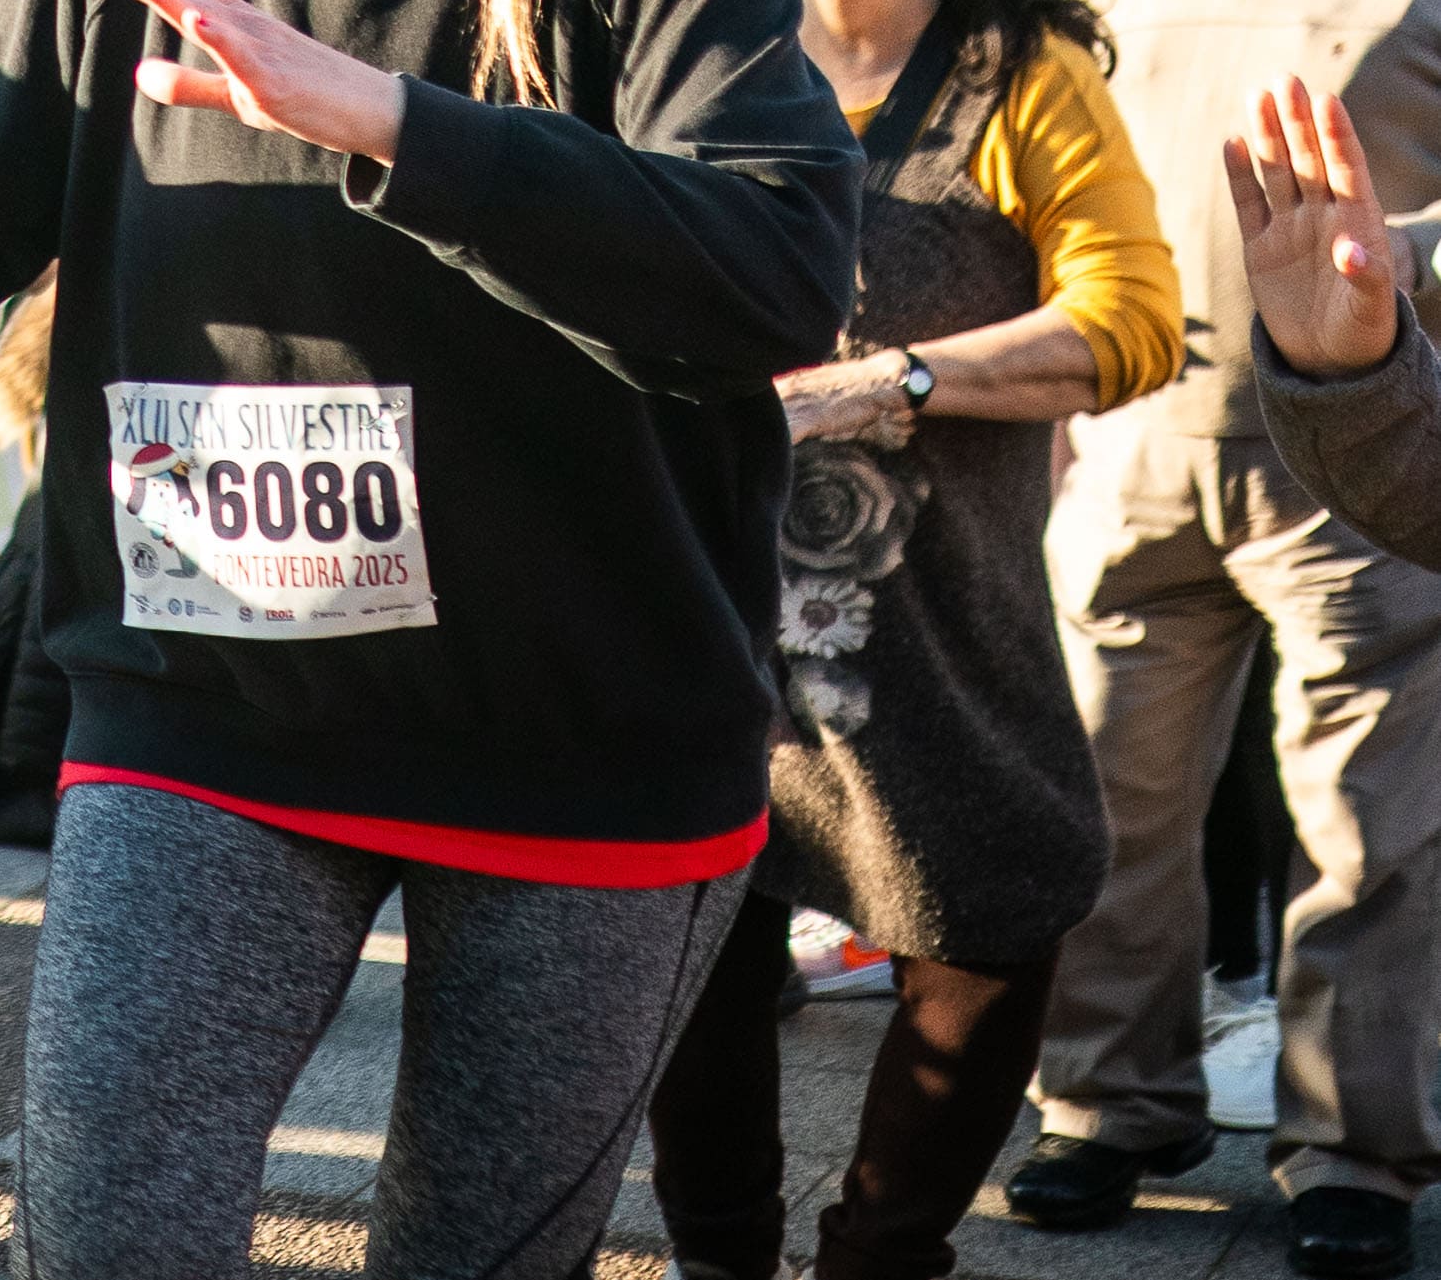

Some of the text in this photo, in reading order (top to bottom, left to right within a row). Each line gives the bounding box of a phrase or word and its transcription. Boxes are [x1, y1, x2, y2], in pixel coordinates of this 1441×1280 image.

[122, 397, 392, 451] XLII SAN SILVESTRE
[207, 460, 402, 542] 6080
[214, 554, 408, 588] PONTEVEDRA 2025
